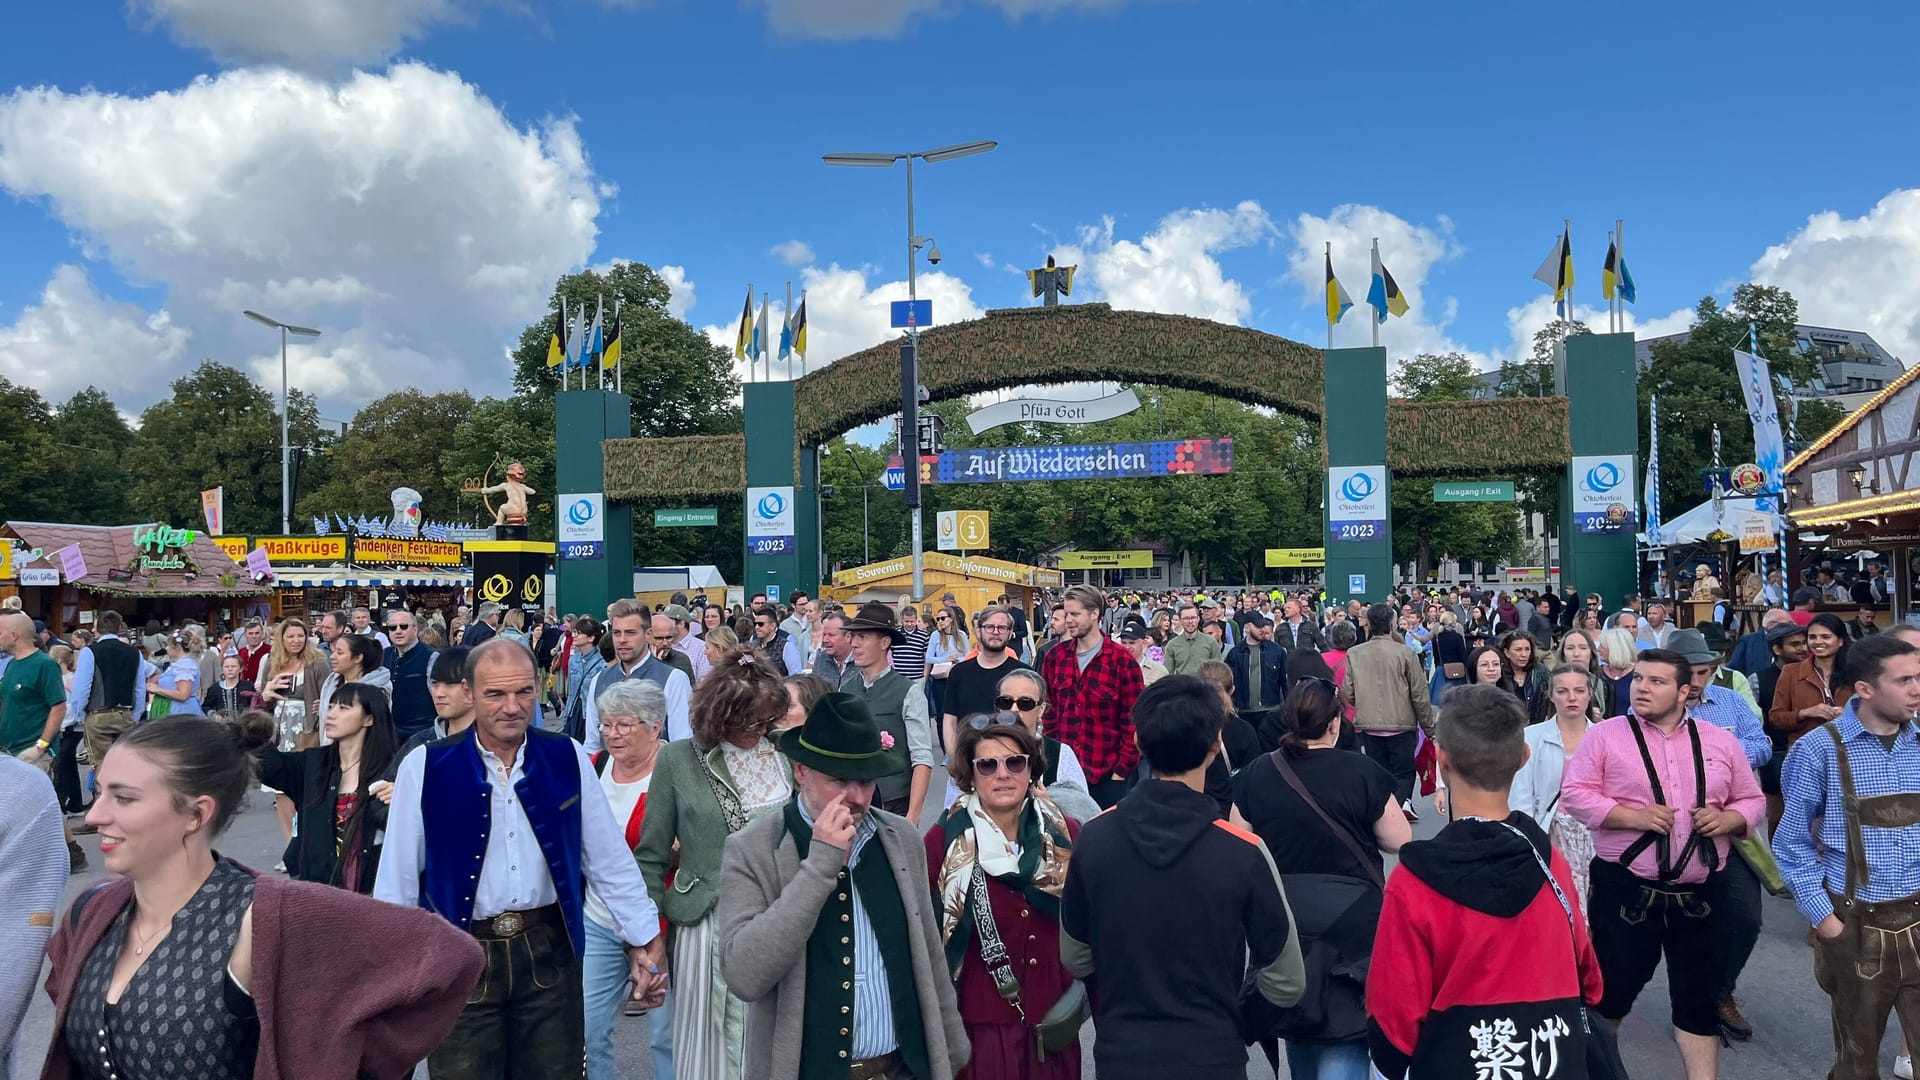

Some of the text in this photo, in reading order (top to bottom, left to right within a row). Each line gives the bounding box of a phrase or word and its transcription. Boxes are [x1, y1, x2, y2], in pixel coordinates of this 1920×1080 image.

[1021, 403, 1086, 419] Pfüa Gott
[965, 449, 1146, 479] Auf Wiedersehen
[1444, 488, 1479, 496] Ausgang
[1583, 495, 1622, 503] Oktoberfest
[657, 514, 682, 522] Eingang
[1342, 525, 1374, 537] 2023
[263, 541, 339, 556] Maßkrüge
[354, 541, 458, 556] Andenken Festkarten
[568, 544, 594, 556] 2023
[758, 539, 785, 551] 2023
[856, 560, 905, 580] Souvenirs
[956, 559, 1016, 579] Information
